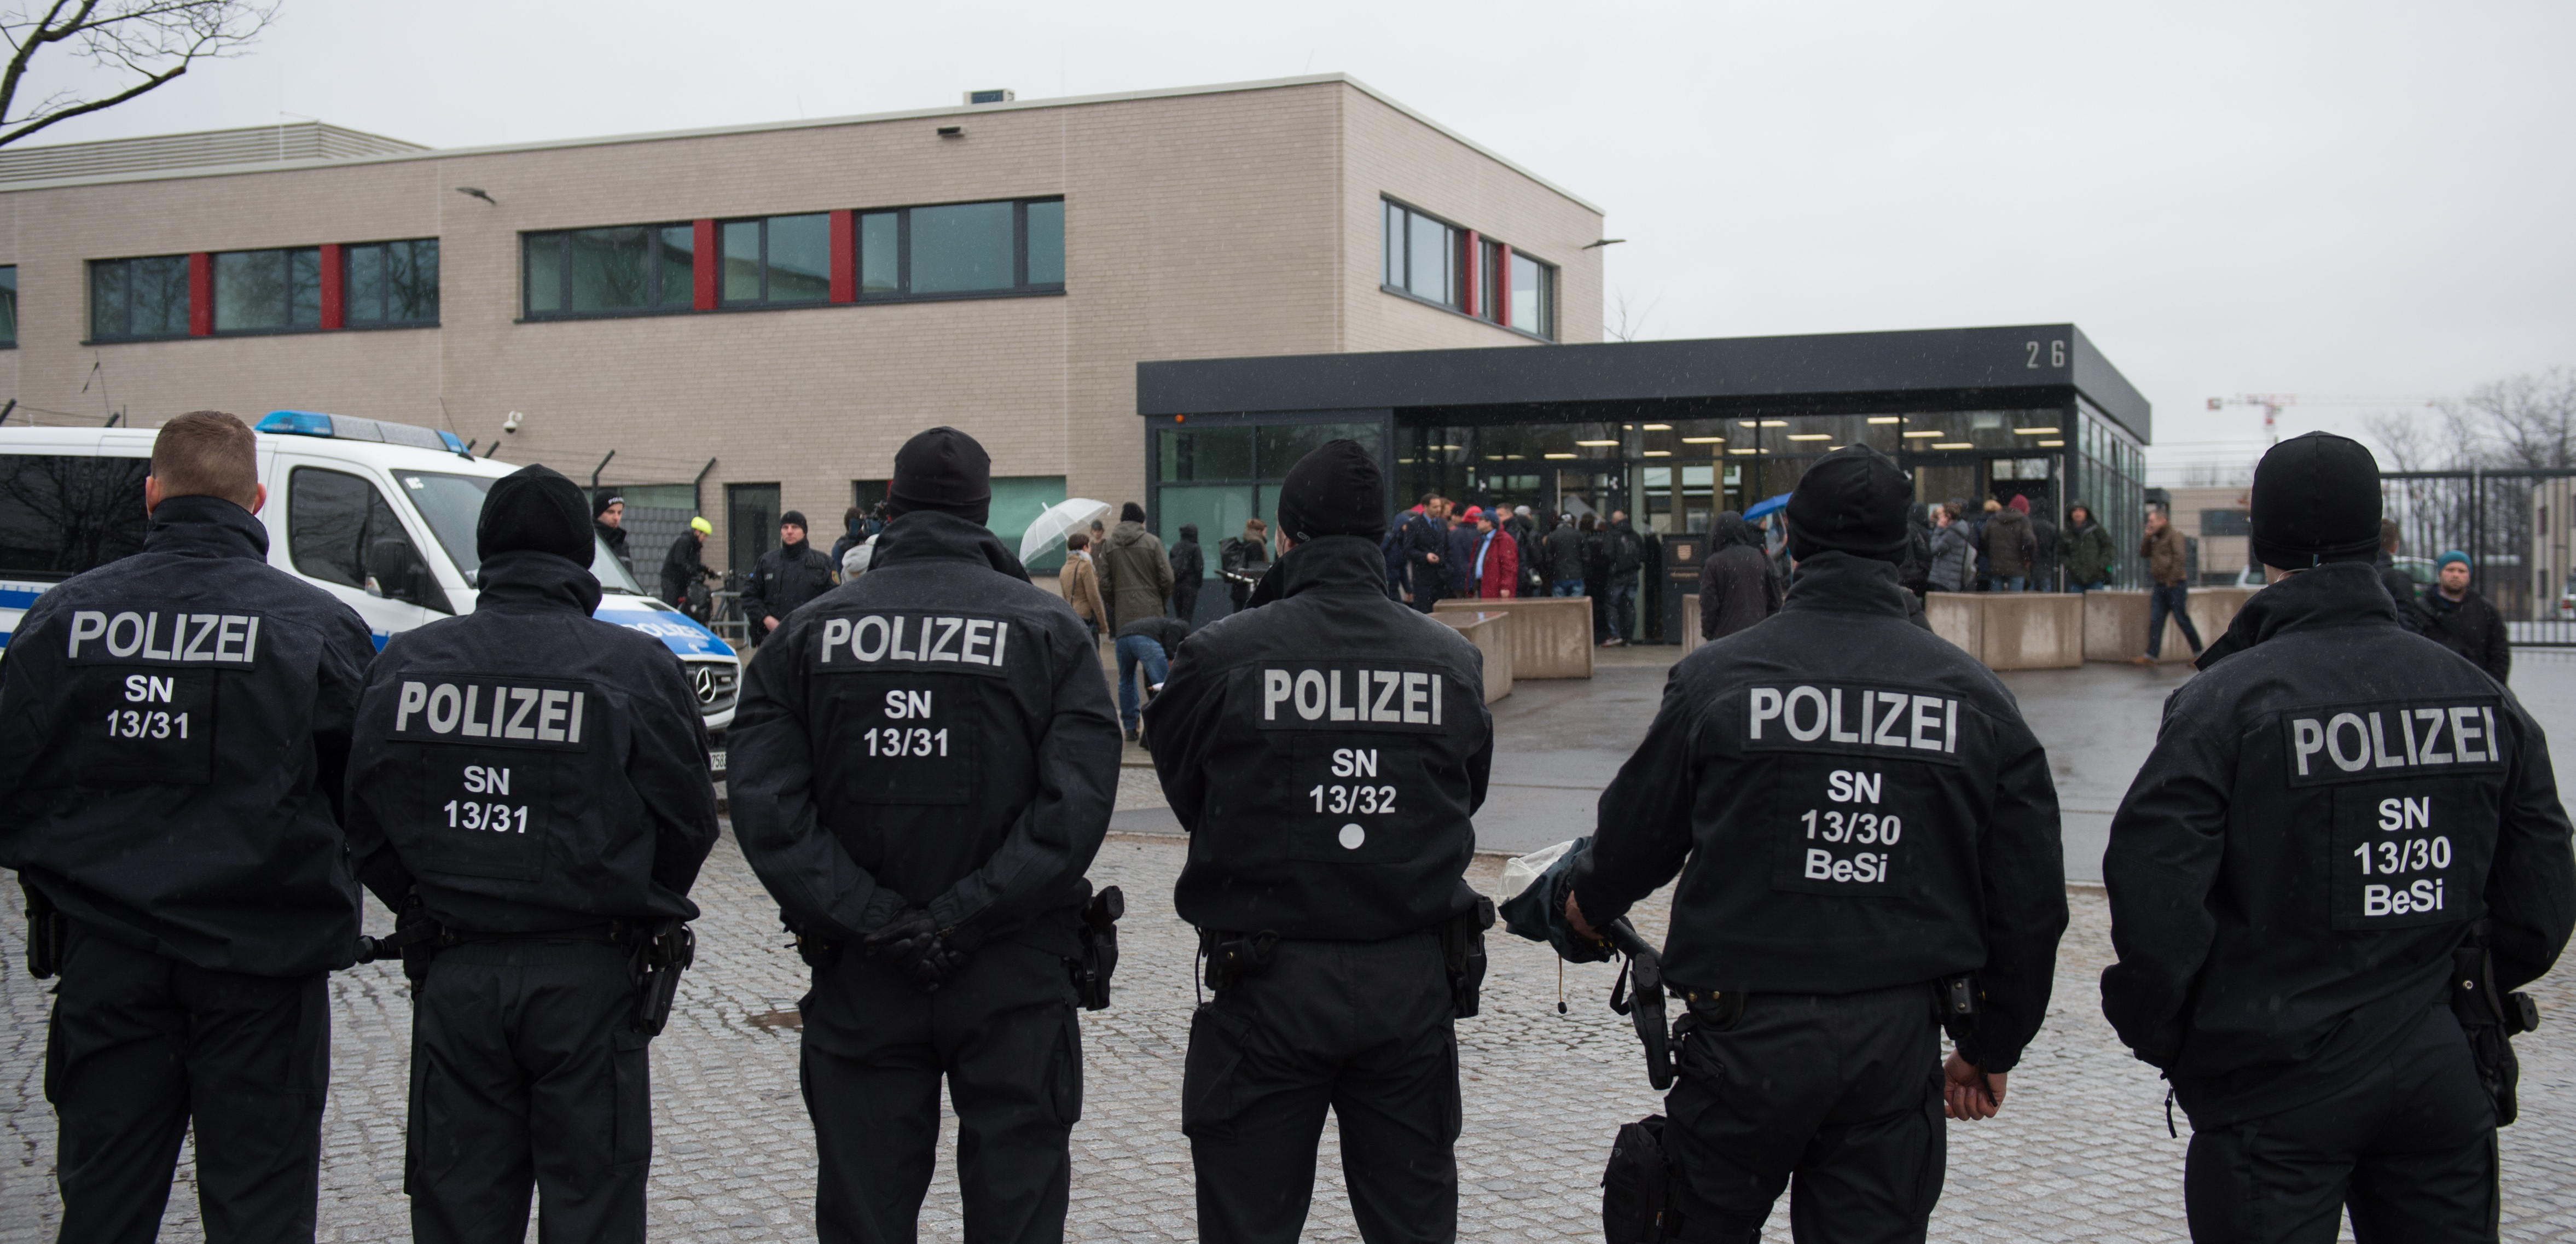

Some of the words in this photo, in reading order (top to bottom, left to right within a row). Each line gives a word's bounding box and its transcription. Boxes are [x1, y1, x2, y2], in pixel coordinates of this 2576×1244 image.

[2027, 340, 2064, 368] 26
[69, 611, 259, 662] POLIZEI
[822, 615, 1007, 666] POLIZEI
[125, 675, 173, 702] SN
[885, 690, 931, 718] SN
[1265, 670, 1441, 724] POLIZEI
[108, 710, 187, 739] 13/31
[396, 682, 583, 742] POLIZEI
[1751, 686, 1957, 753] POLIZEI
[865, 728, 947, 756] 13/31
[2293, 707, 2498, 775] POLIZEI
[1332, 749, 1377, 777] SN
[465, 766, 509, 795] SN
[1828, 770, 1881, 803] SN
[1310, 785, 1396, 813] 13/32
[2379, 797, 2429, 830] SN
[445, 800, 527, 833] 13/31
[1802, 810, 1900, 845] 13/30
[1805, 848, 1887, 882] BeSi
[2354, 836, 2451, 874] 13/30
[2365, 879, 2442, 916] BeSi
